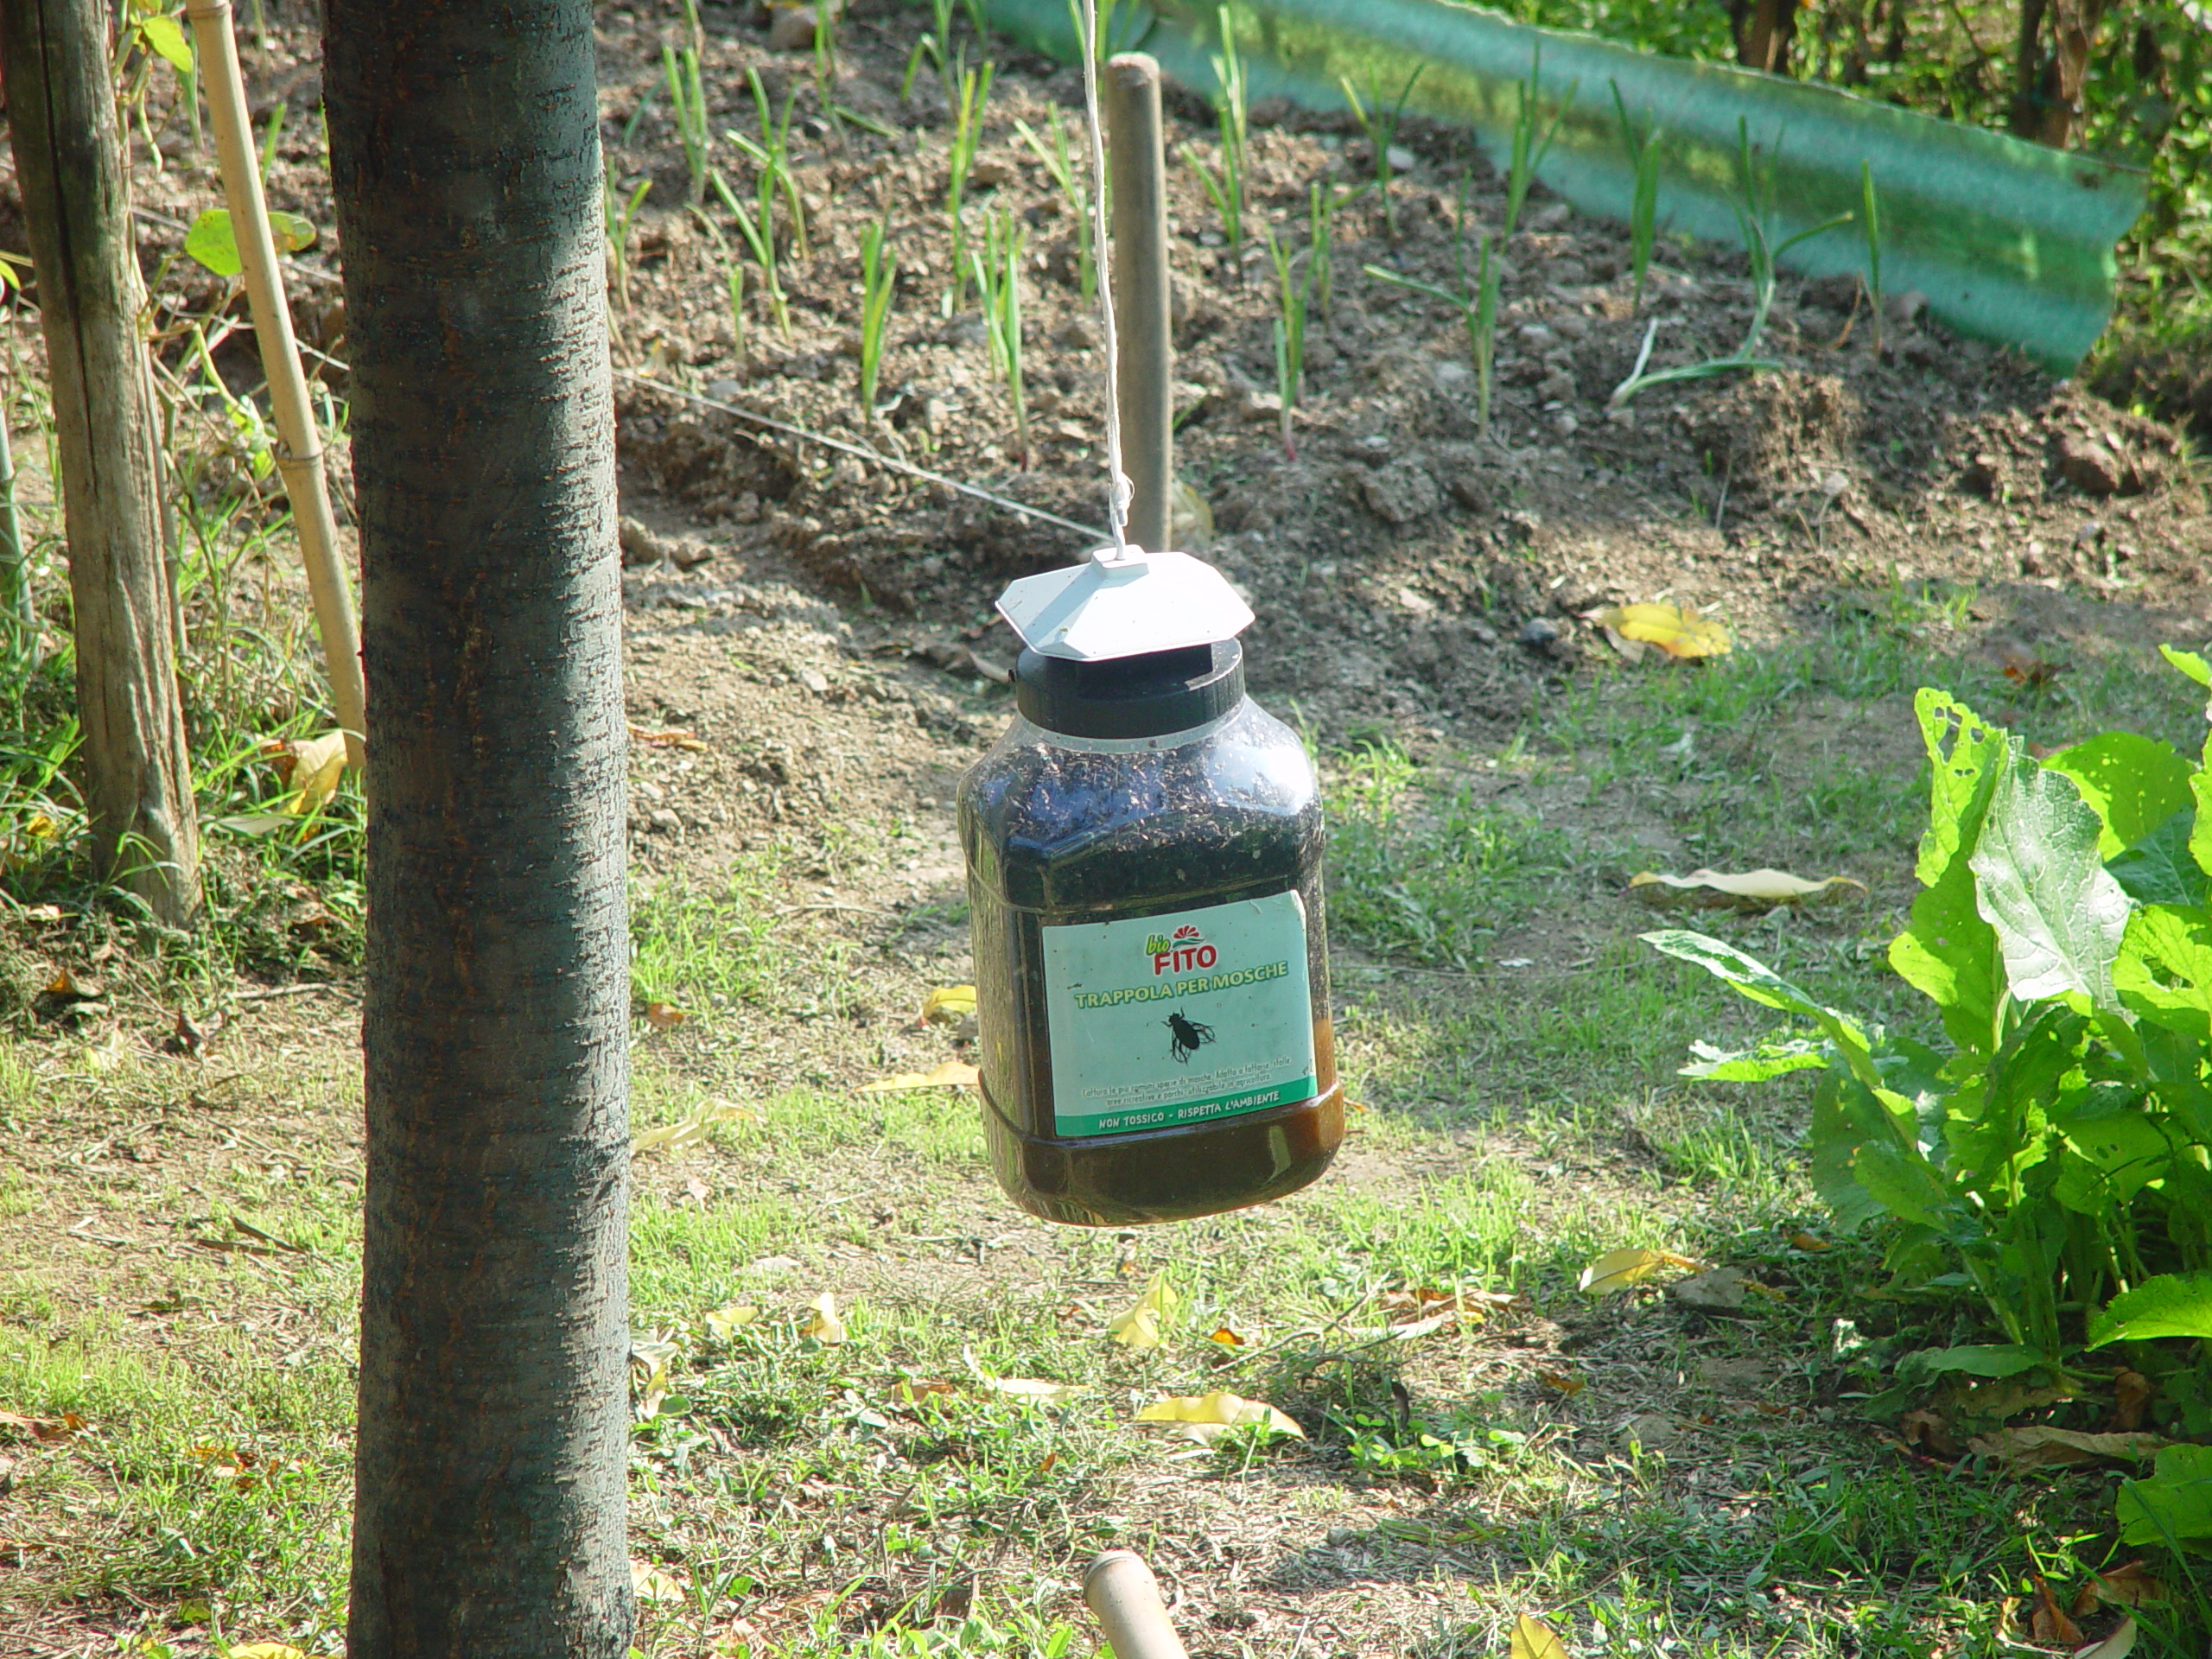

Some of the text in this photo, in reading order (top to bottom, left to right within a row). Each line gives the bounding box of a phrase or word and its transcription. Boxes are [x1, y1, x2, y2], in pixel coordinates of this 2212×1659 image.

[1147, 934, 1171, 956] bio
[1154, 944, 1217, 976] FITO
[1075, 960, 1288, 1008] TRAPPOLA PER MOSCHE
[1109, 1085, 1116, 1095] le
[1179, 1075, 1186, 1084] di
[1227, 1079, 1234, 1088] in
[1098, 1117, 1121, 1129] NON
[1123, 1112, 1164, 1126] TOSSICO
[1177, 1102, 1222, 1120] RISPETTA
[1225, 1090, 1280, 1110] L'AMBIENTE
